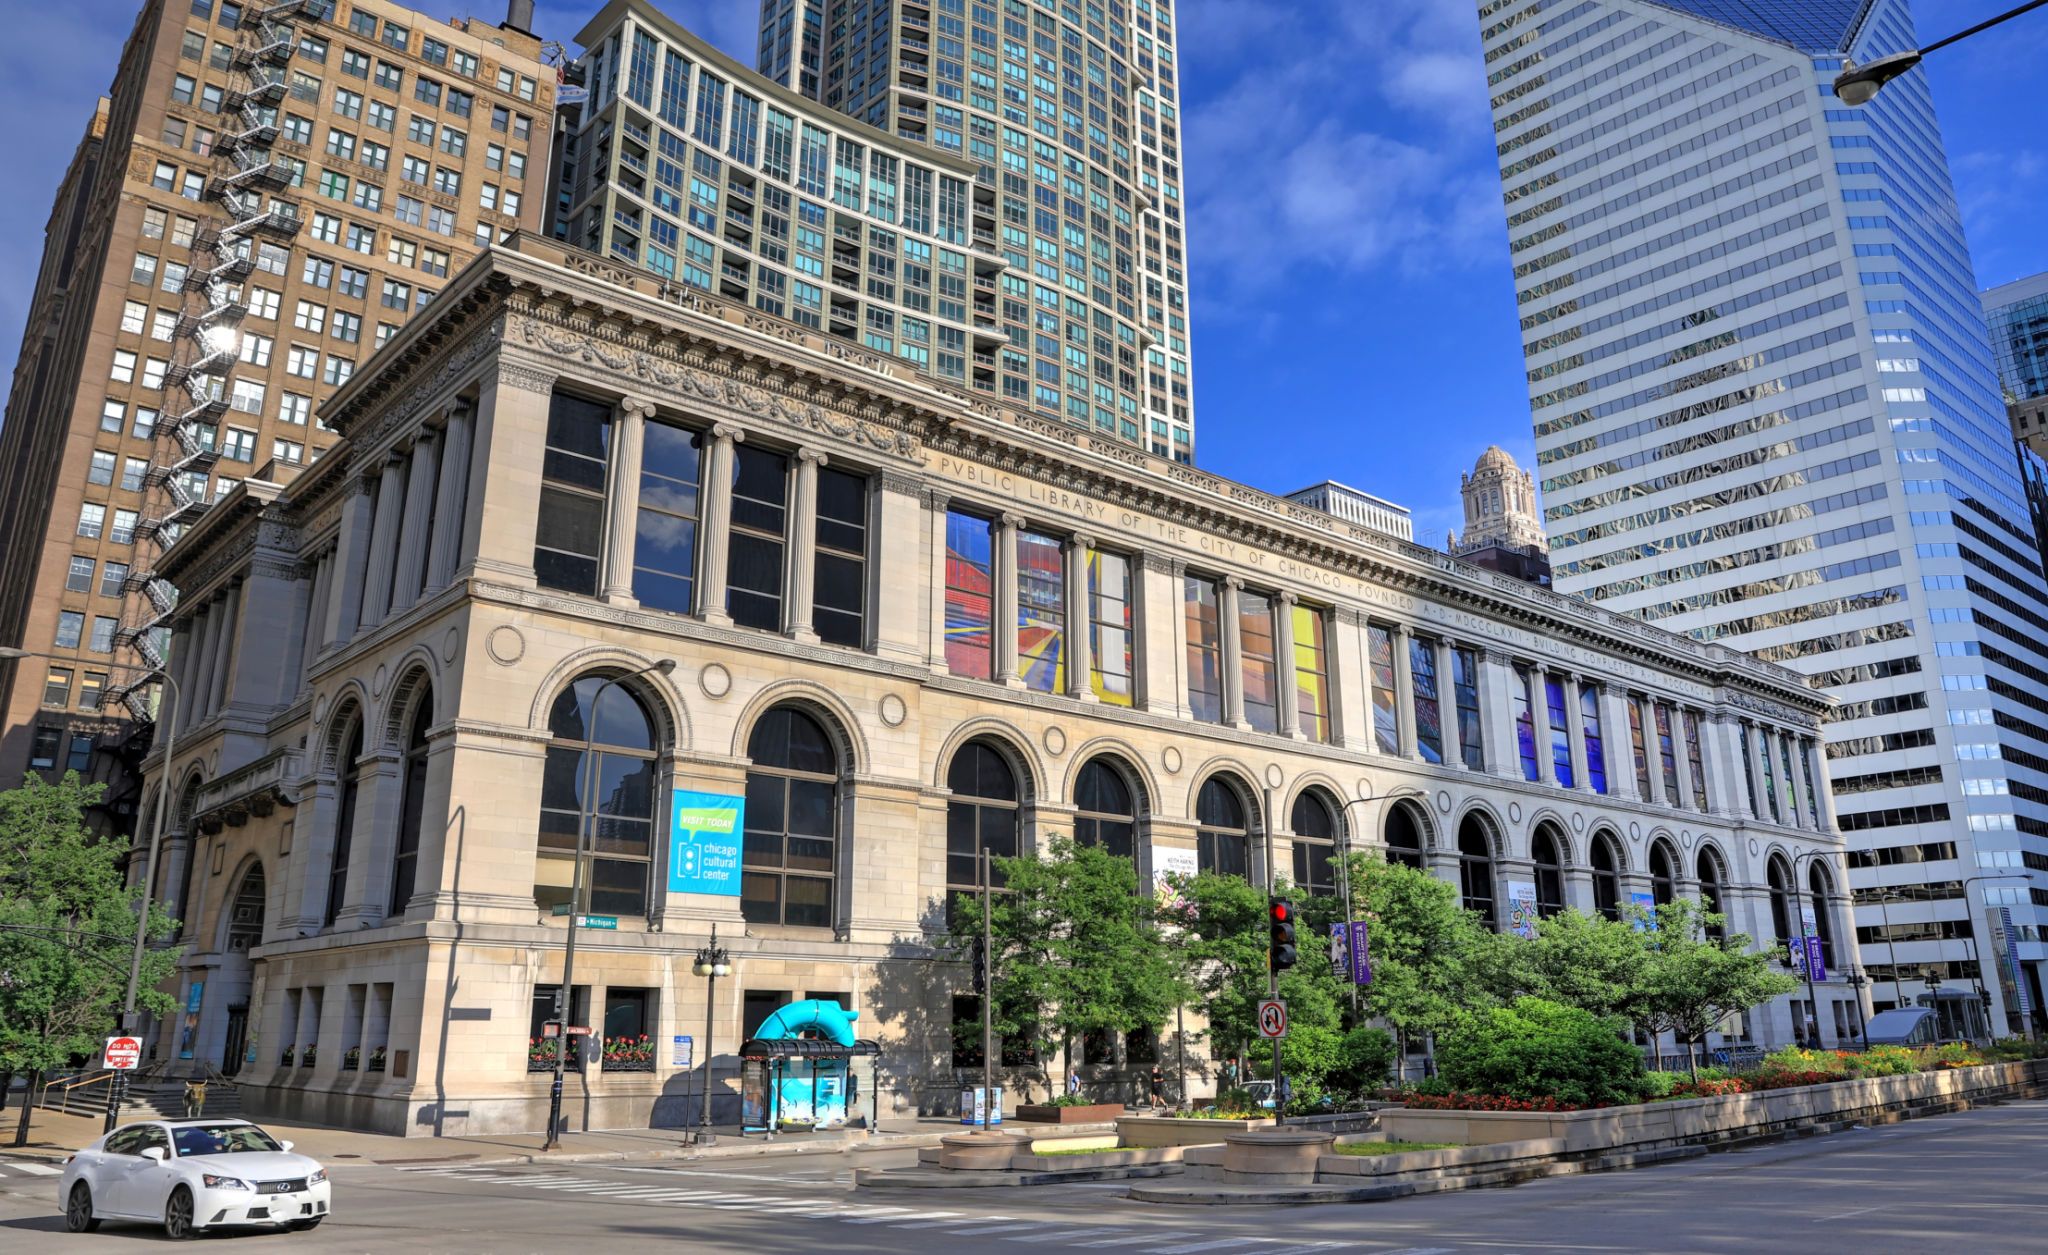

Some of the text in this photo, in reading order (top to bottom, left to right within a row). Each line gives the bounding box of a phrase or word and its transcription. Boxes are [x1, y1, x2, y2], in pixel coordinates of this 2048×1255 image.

[941, 457, 1011, 492] PVBLIC
[1029, 486, 1105, 519] LIBRARY
[1121, 512, 1142, 529] OF
[1157, 522, 1187, 544] THE
[1200, 536, 1236, 559] CITY
[1249, 551, 1267, 567] OF
[1279, 560, 1341, 588] CHICAGO
[1357, 582, 1414, 610] FOVNDED
[1583, 652, 1634, 676] COMPLETED
[682, 815, 732, 828] VISIT TODAY
[703, 842, 737, 857] chicago
[703, 857, 736, 868] cultural
[702, 869, 730, 880] center
